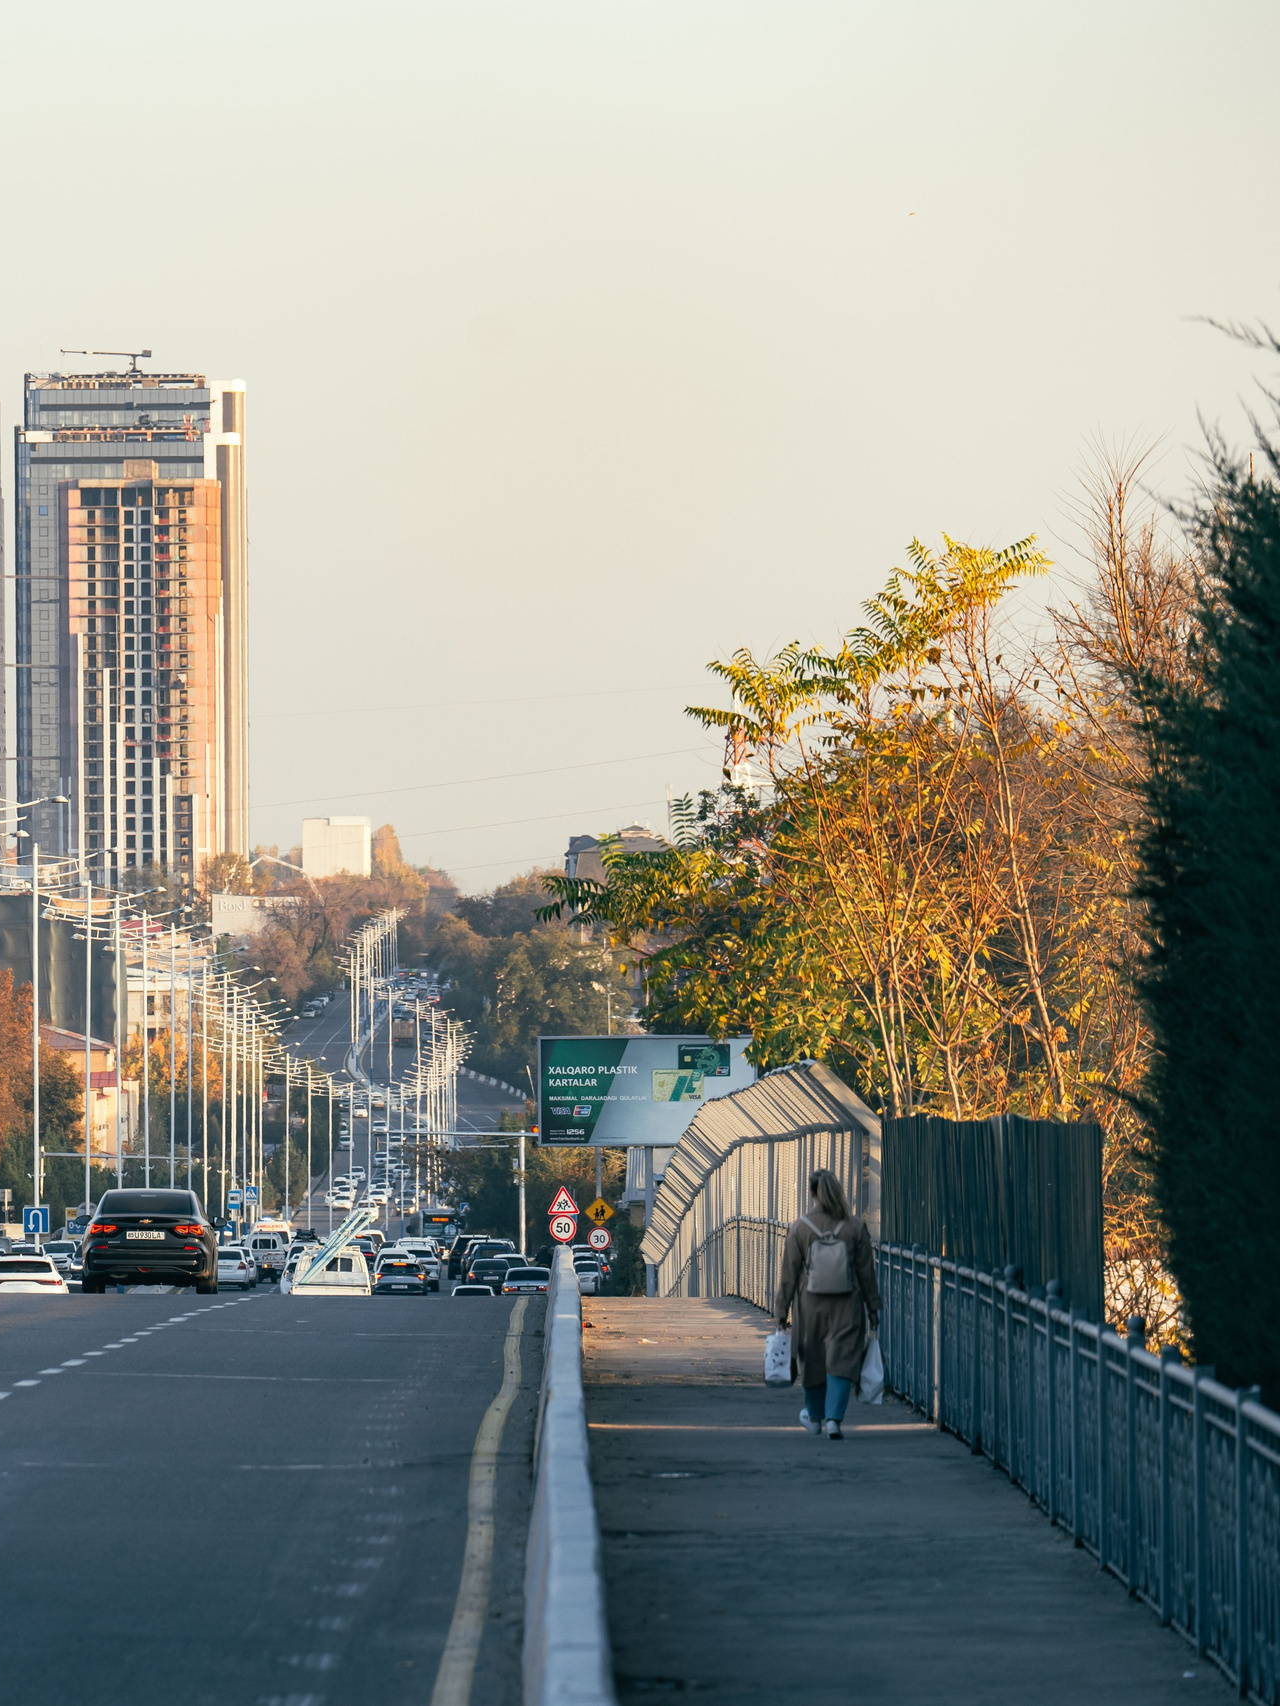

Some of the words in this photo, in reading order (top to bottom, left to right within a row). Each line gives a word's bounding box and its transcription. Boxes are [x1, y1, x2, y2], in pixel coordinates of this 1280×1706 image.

[548, 1066, 595, 1075] XALQARO
[598, 1065, 638, 1075] PLASTIK
[550, 1106, 571, 1115] VISA
[556, 1223, 570, 1233] 50
[594, 1235, 605, 1243] 30
